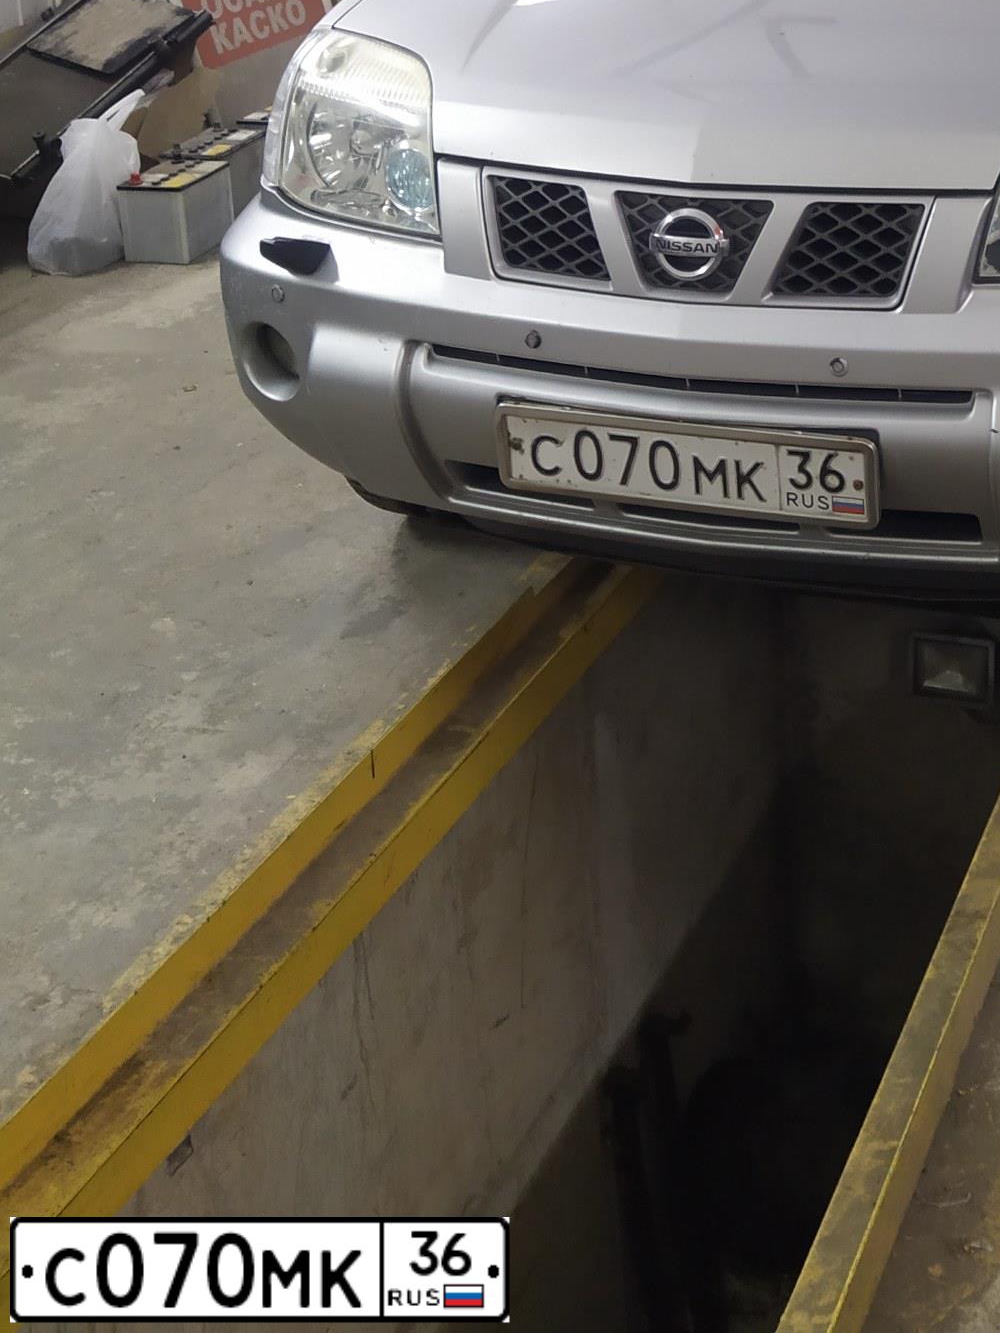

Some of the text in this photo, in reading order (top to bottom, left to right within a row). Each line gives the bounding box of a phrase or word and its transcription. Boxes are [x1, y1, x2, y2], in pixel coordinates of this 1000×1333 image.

[655, 239, 719, 254] NISSAN
[786, 449, 846, 493] 36
[785, 492, 830, 511] RUS
